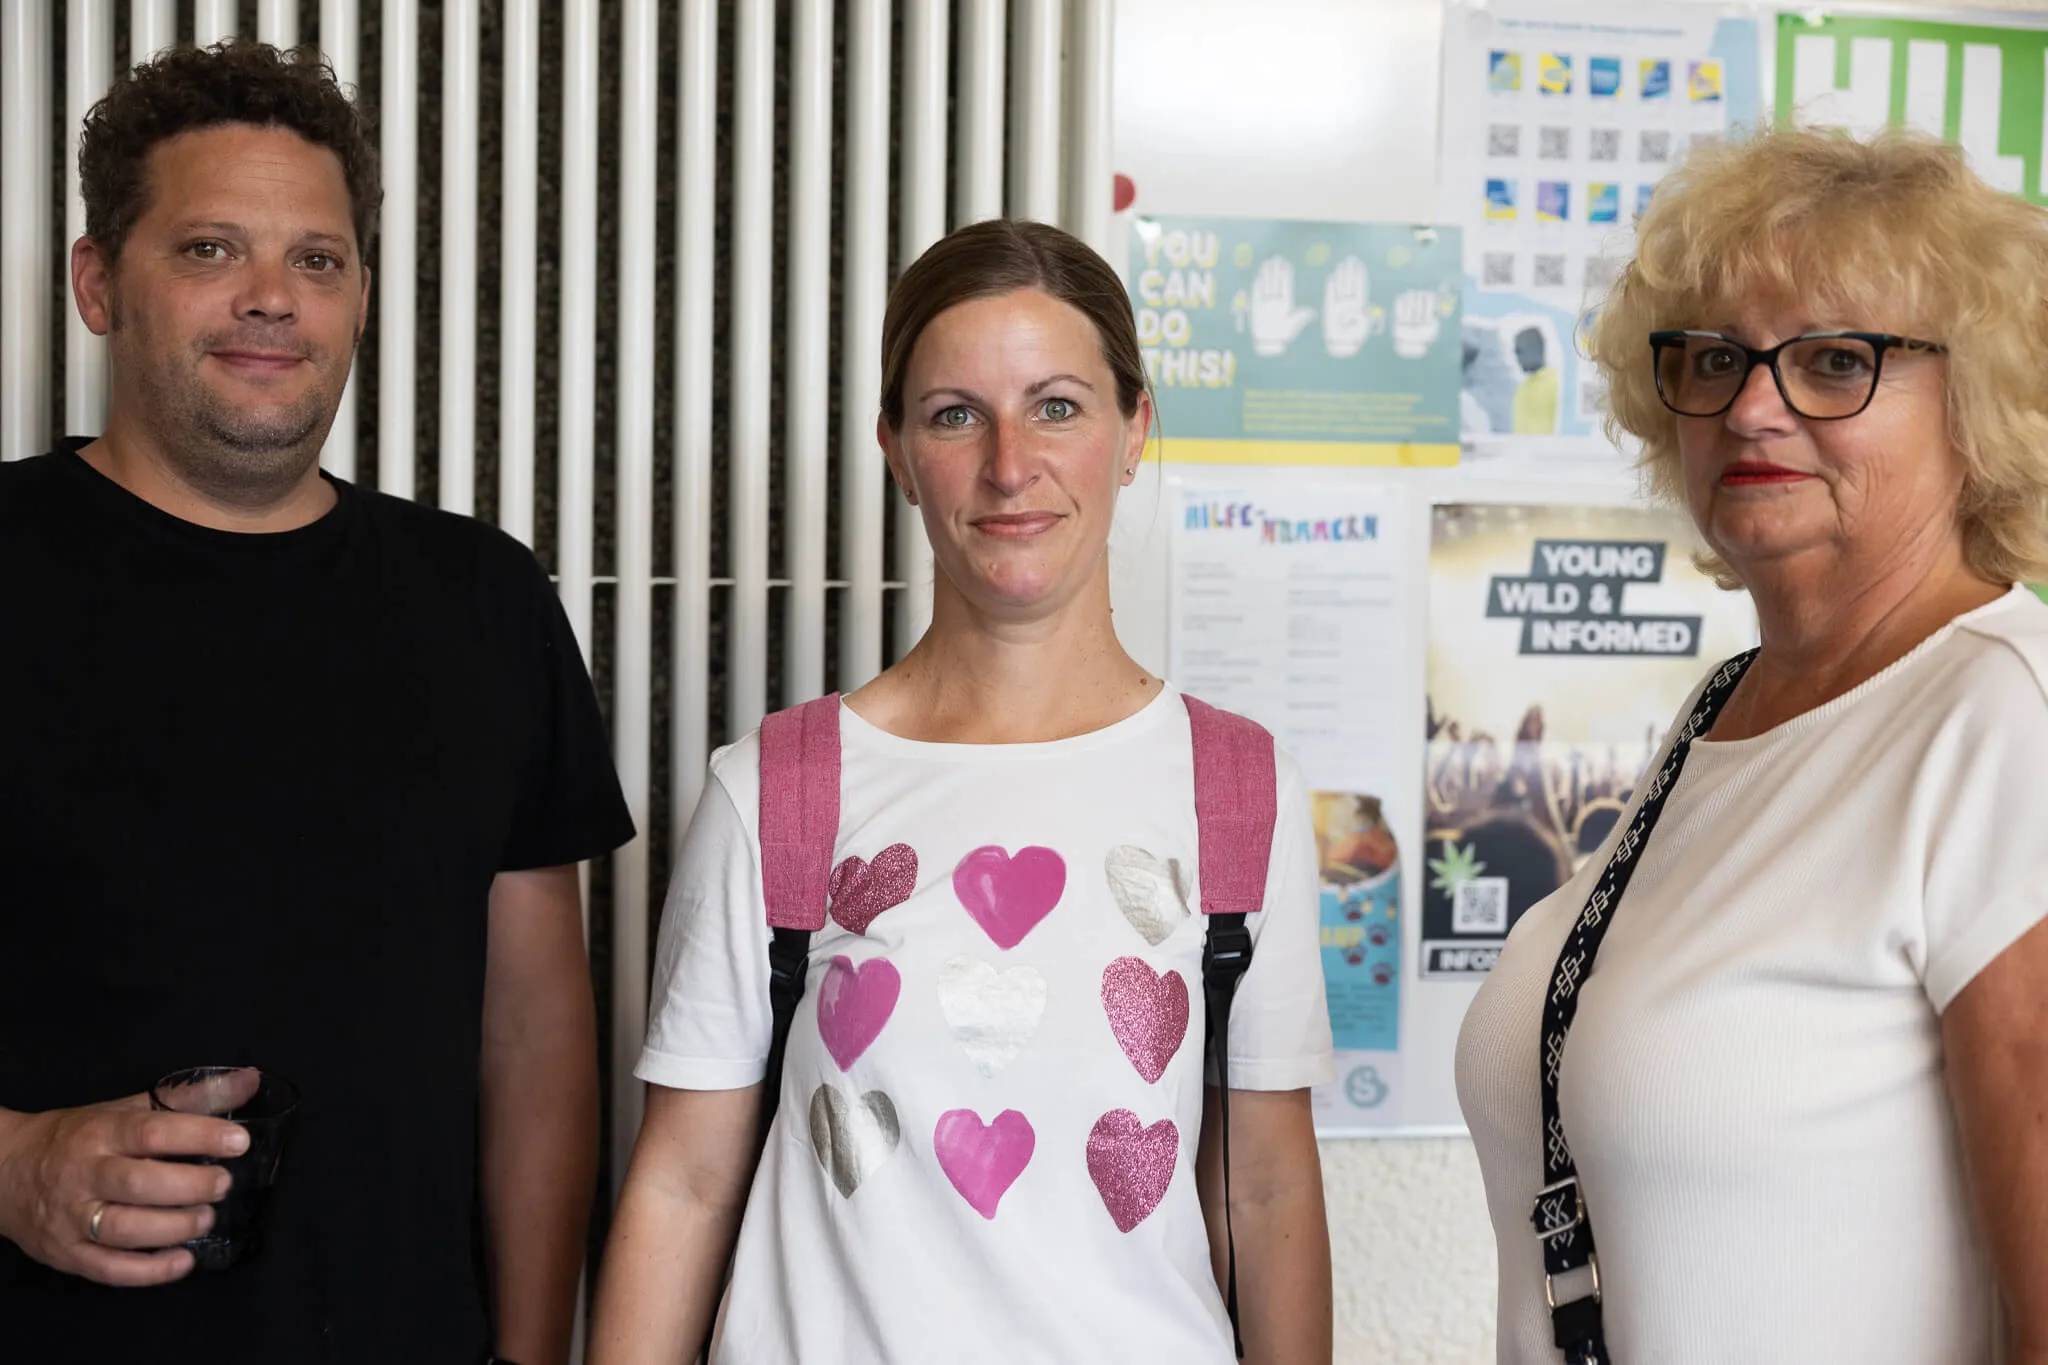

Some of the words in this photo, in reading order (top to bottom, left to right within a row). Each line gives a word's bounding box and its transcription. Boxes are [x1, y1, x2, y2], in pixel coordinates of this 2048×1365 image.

[1792, 35, 2048, 196] HIL
[1139, 229, 1217, 266] YOU
[1138, 270, 1215, 307] CAN
[1137, 308, 1191, 346] DO
[1141, 349, 1236, 387] THIS!
[1541, 545, 1655, 577] YOUNG
[1497, 582, 1580, 612] WILD
[1588, 584, 1613, 613] &
[1530, 621, 1693, 653] INFORMED
